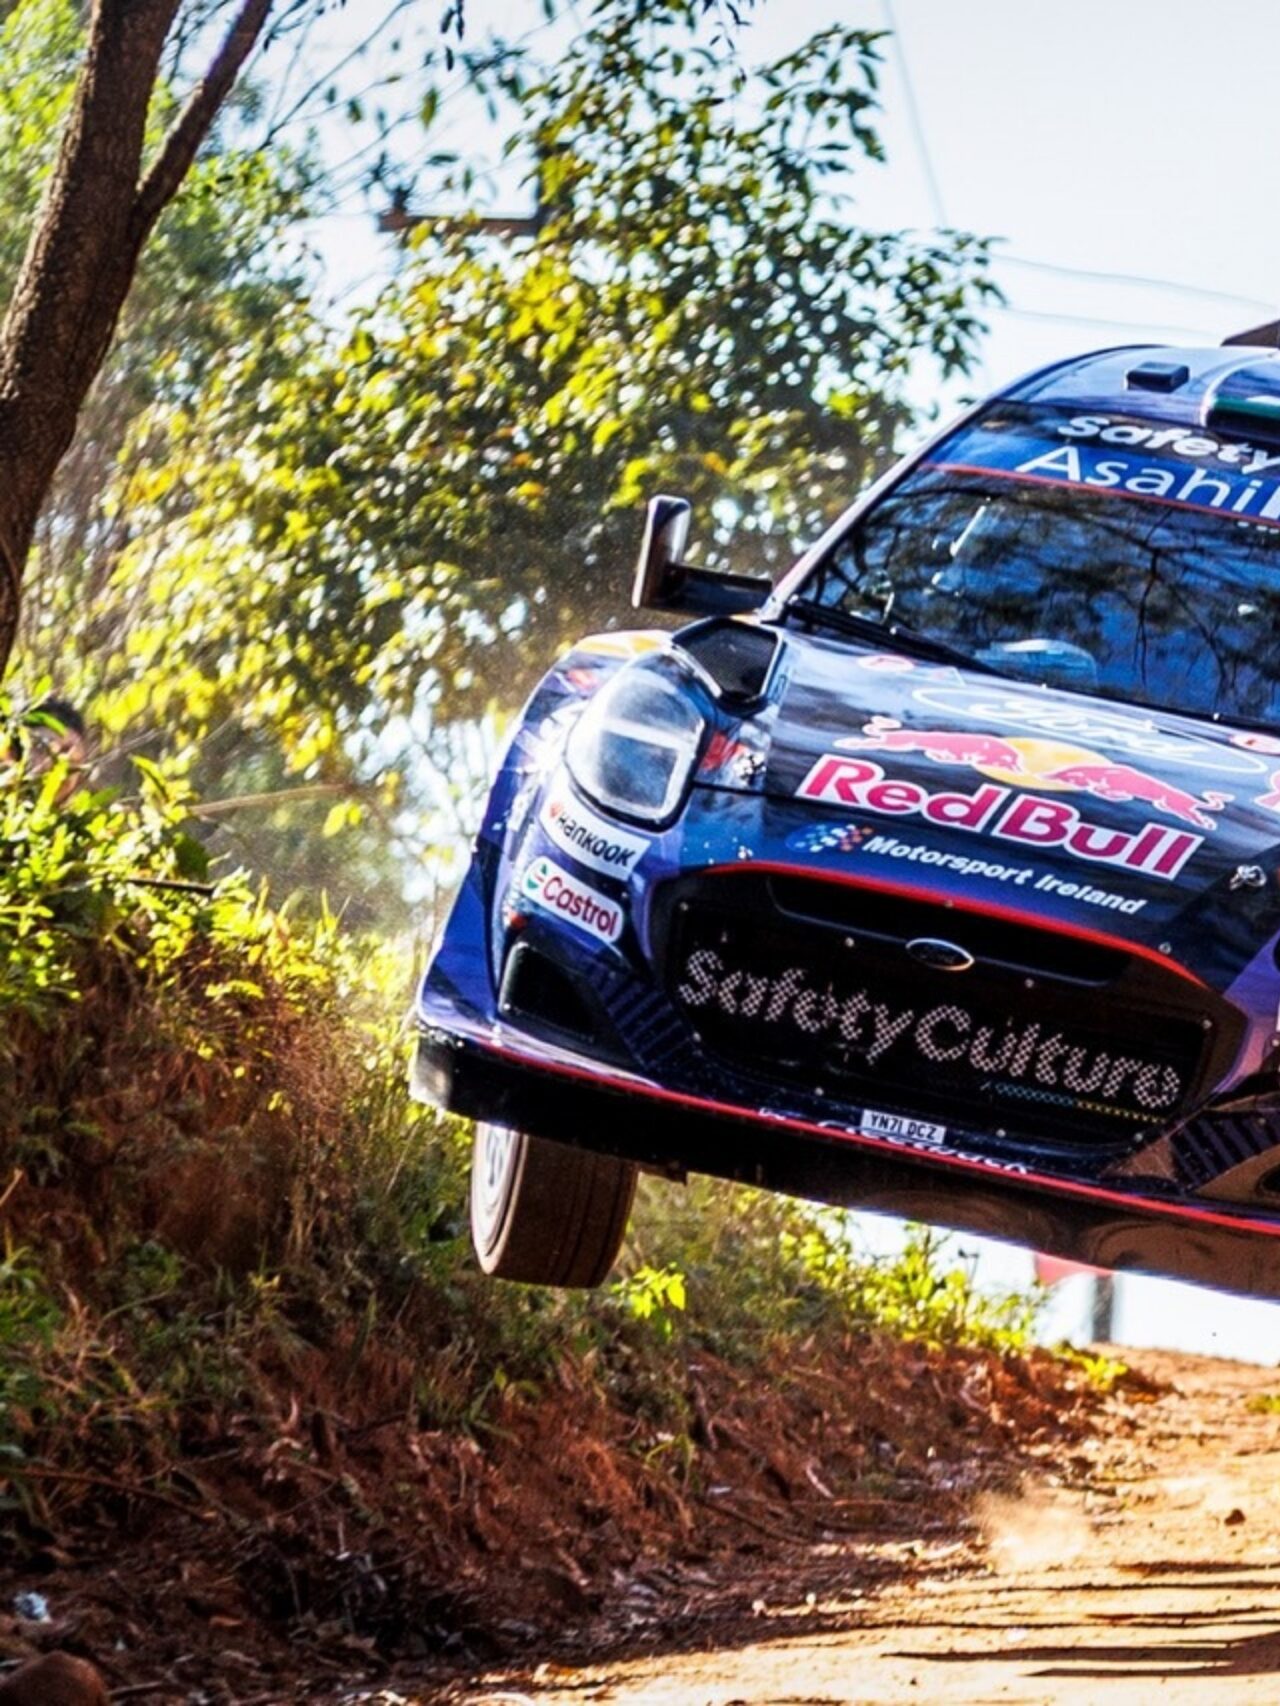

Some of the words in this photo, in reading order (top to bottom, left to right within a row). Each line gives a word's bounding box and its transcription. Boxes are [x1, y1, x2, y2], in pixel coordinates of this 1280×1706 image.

[795, 754, 1009, 830] Red
[991, 794, 1204, 880] Bull
[542, 876, 619, 937] Castrol
[863, 835, 1032, 886] Motorsport
[1034, 873, 1147, 915] Ireland
[679, 949, 1181, 1108] SafetyCulture
[907, 1123, 938, 1140] DCZ
